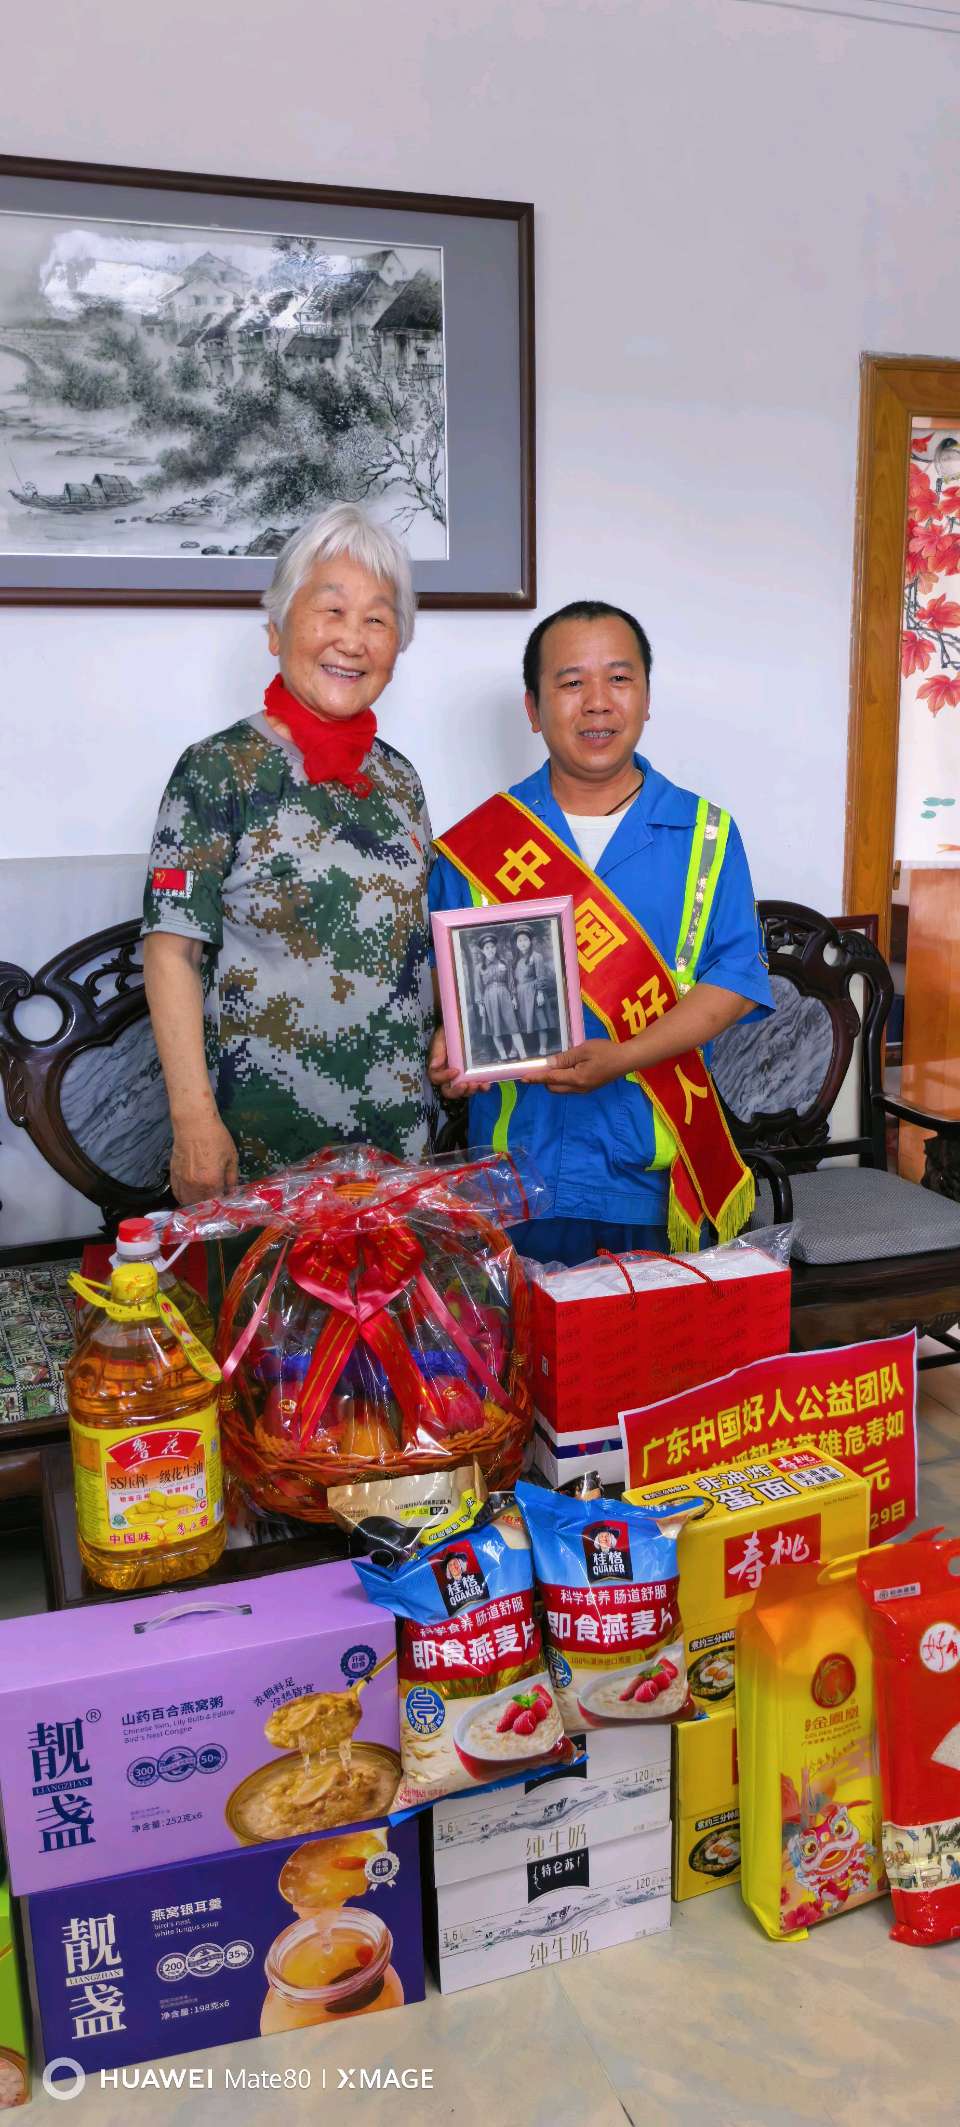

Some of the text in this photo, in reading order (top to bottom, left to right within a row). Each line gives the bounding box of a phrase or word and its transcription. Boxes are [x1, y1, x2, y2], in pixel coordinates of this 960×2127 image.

[494, 838, 708, 1126] 中国好人
[642, 1362, 904, 1479] 广东中国好人公益团队
[694, 1463, 774, 1493] 非油炸
[711, 1476, 801, 1512] 蛋面
[869, 1500, 906, 1531] 29日
[109, 1531, 151, 1545] 中国味
[592, 1563, 625, 1576] QUAKER
[593, 1551, 623, 1566] 桂格
[727, 1531, 811, 1589] 寿桃
[446, 1573, 478, 1596] 桂格
[449, 1585, 484, 1607] QUAKER
[560, 1583, 667, 1607] 科学食养 肠道舒服
[475, 1595, 525, 1627] 肠道舒服
[546, 1604, 673, 1645] 即食燕麦片
[412, 1617, 536, 1671] 即食燕麦片
[121, 1695, 225, 1727] 山药百合燕窝粥
[135, 1766, 154, 1777] 300
[34, 1778, 91, 1795] LIANGZHAN
[526, 1823, 587, 1861] 纯牛奶
[541, 1856, 576, 1875] 特仑苏
[150, 1897, 223, 1922] 燕窝银耳羹
[529, 1930, 591, 1969] 纯牛奶
[69, 1969, 122, 1986] LIANGZHAN
[164, 1961, 183, 1972] 200
